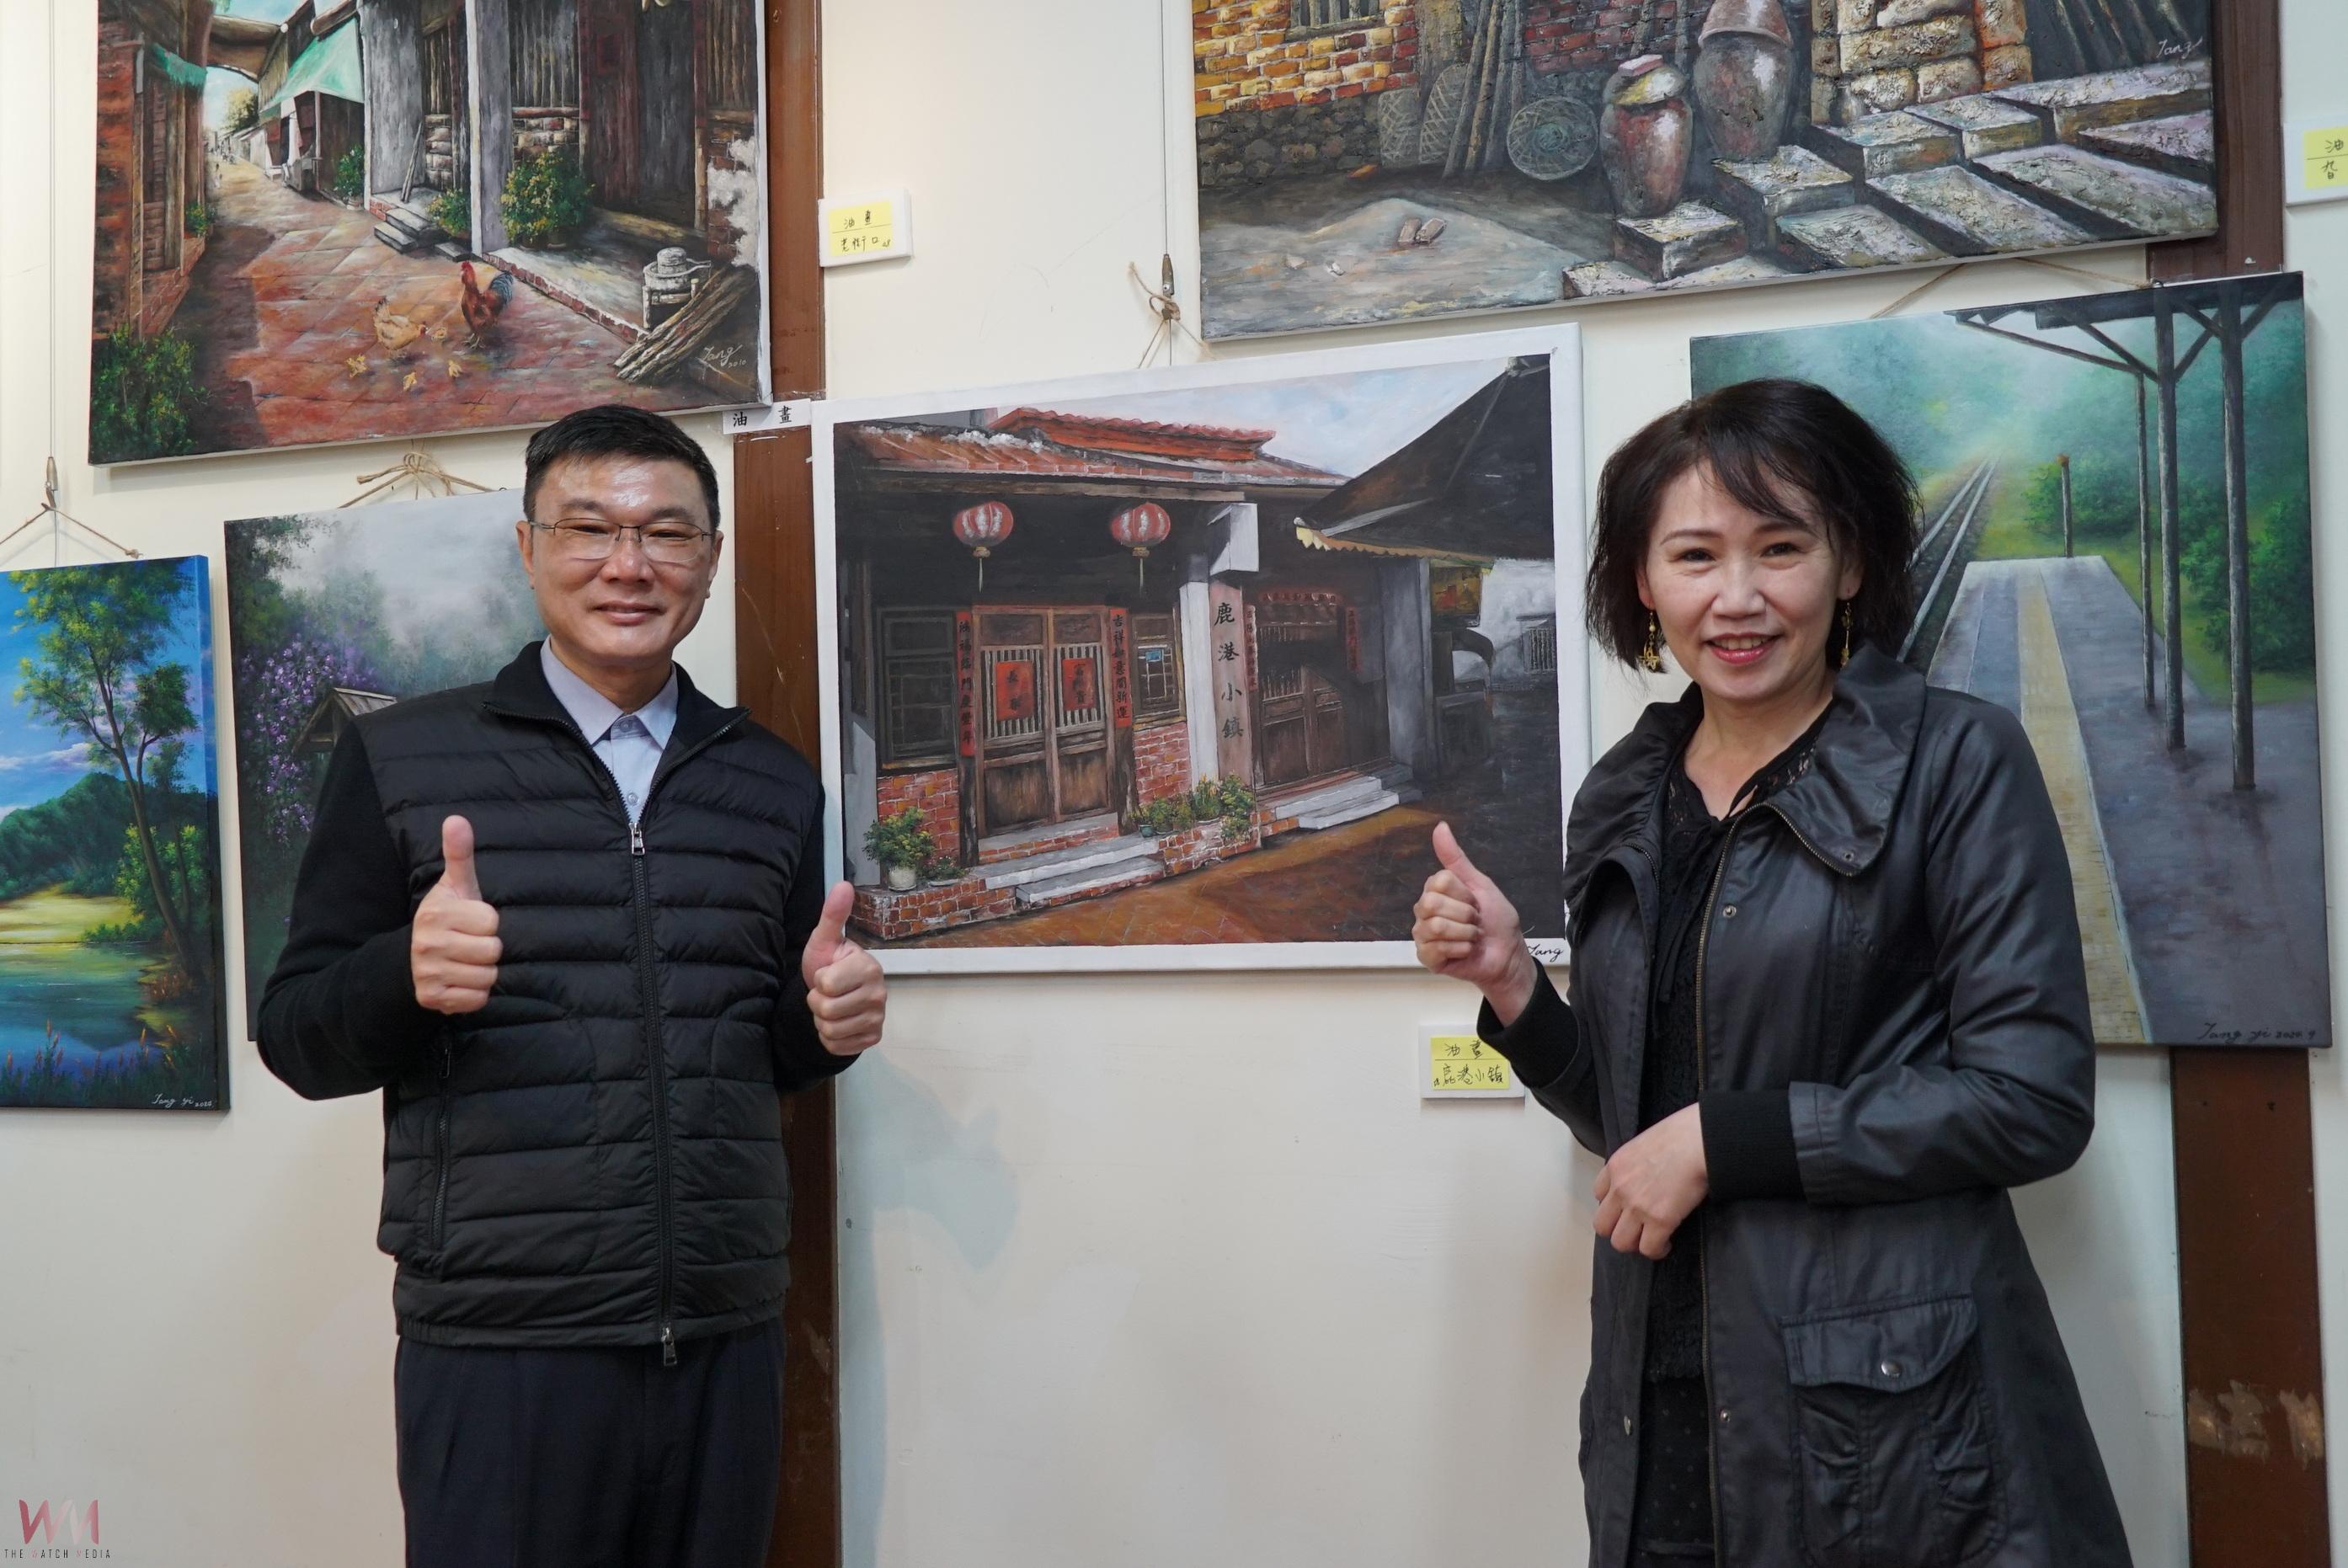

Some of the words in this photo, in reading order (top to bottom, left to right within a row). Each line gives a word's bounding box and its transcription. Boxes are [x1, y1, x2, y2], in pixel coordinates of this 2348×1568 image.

[2324, 139, 2344, 153] 油
[732, 405, 793, 428] 油畫
[1214, 602, 1244, 739] 鹿港小鎮
